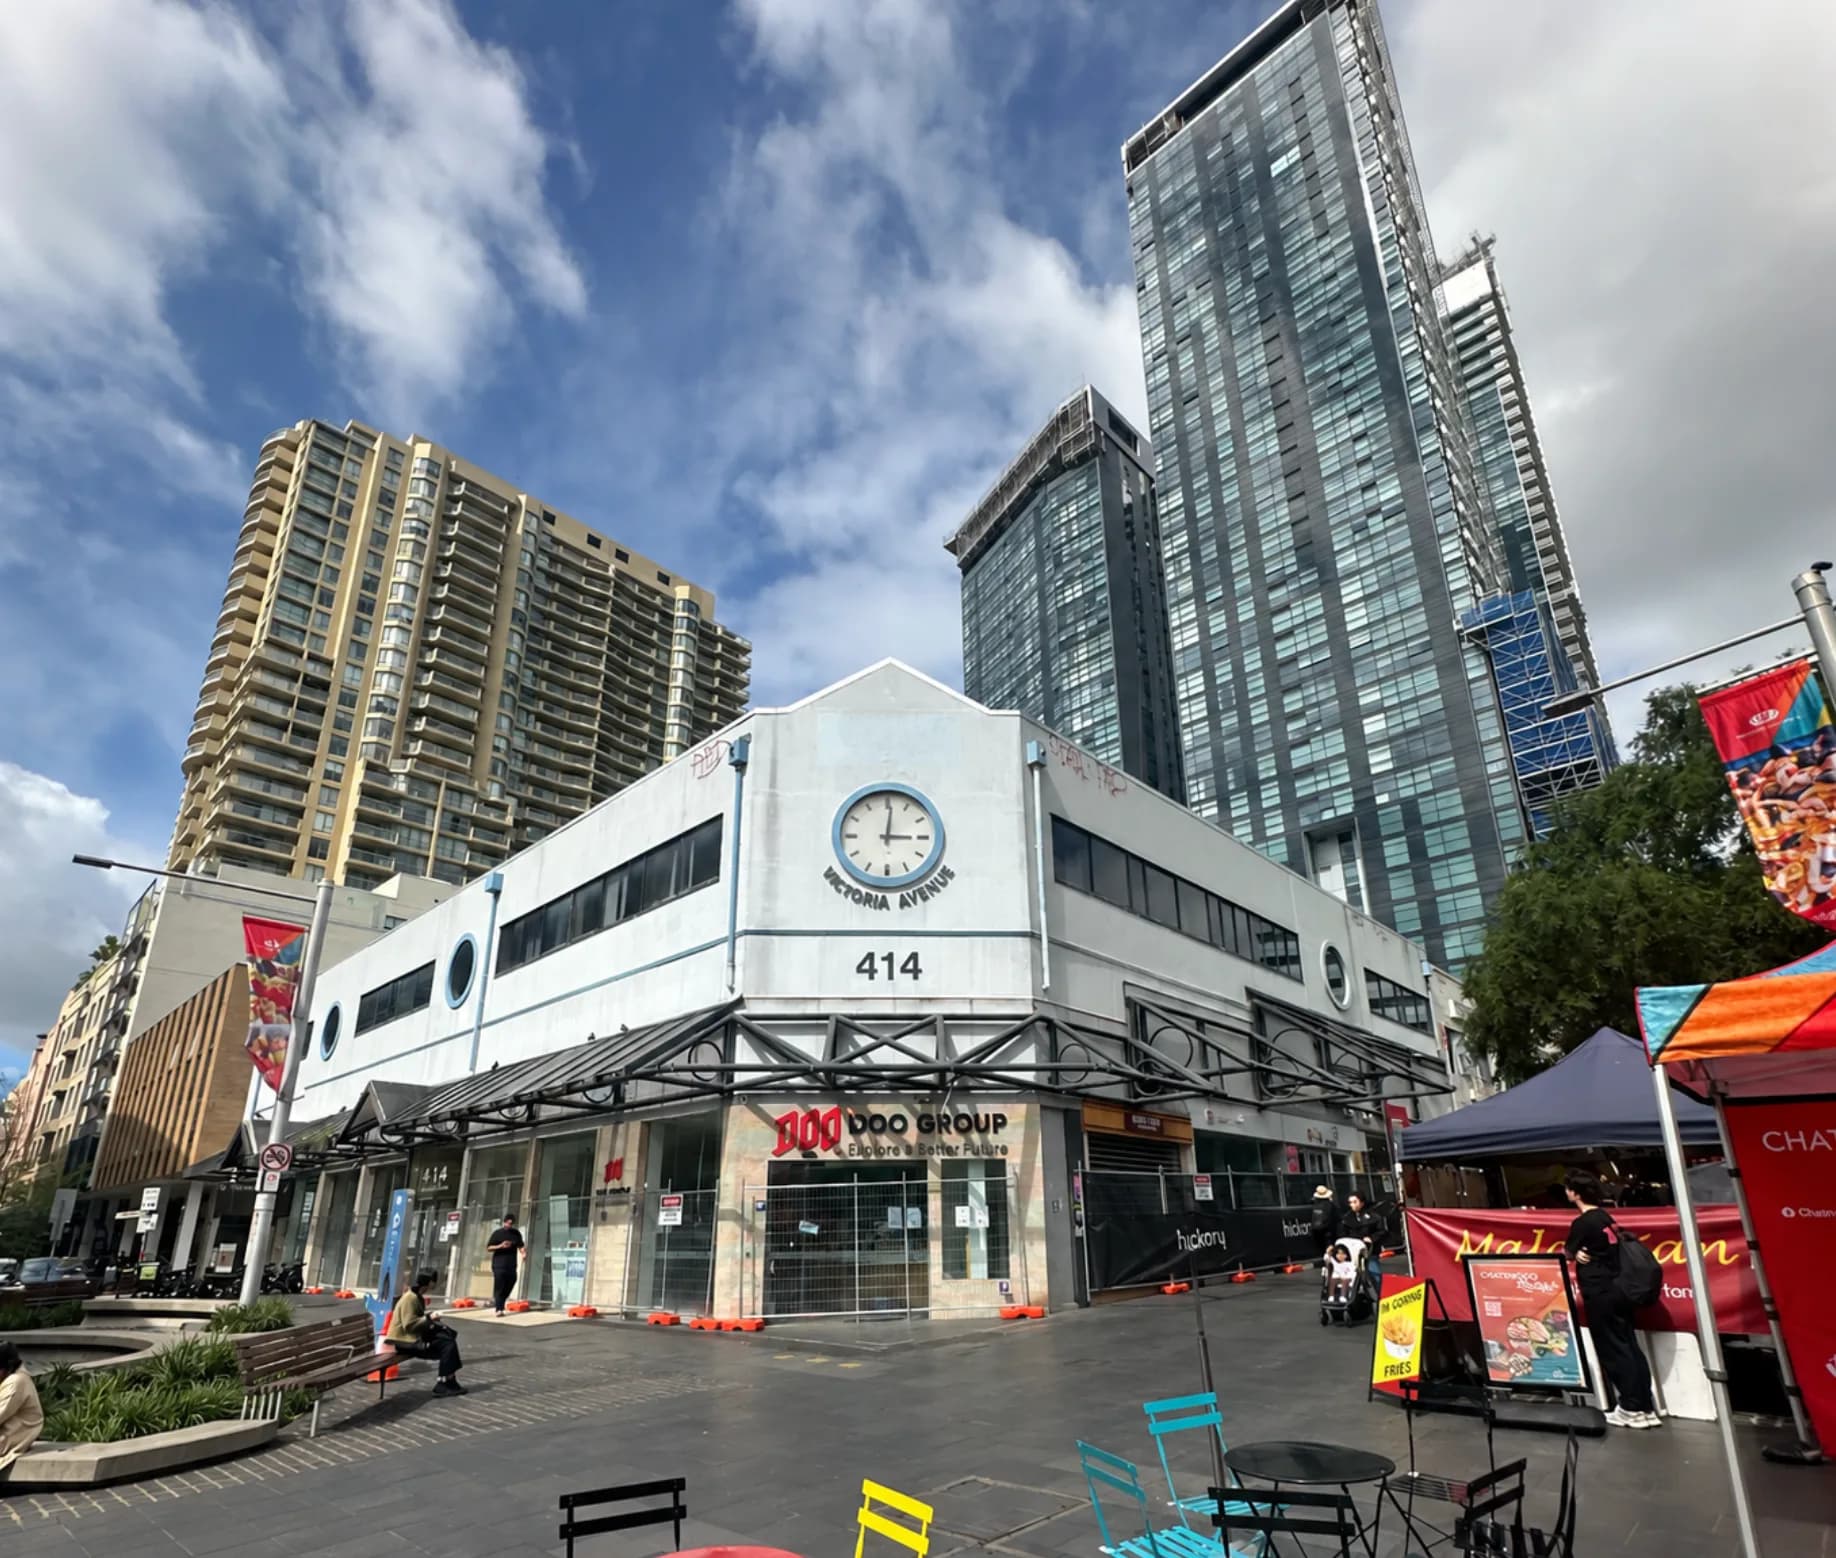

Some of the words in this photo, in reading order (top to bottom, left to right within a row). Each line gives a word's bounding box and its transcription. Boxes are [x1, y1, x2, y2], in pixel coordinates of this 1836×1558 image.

[823, 866, 890, 911] VICTORIA
[899, 865, 956, 910] AVENUE
[856, 951, 923, 981] 414
[849, 1112, 908, 1135] DOO
[917, 1112, 1008, 1135] GROUP
[848, 1143, 901, 1158] Explore
[919, 1143, 959, 1156] Better
[963, 1143, 1008, 1156] Future
[422, 1165, 448, 1184] 414
[1282, 1218, 1312, 1238] hickor
[1176, 1228, 1227, 1251] hickory
[1384, 1361, 1412, 1377] FRIES
